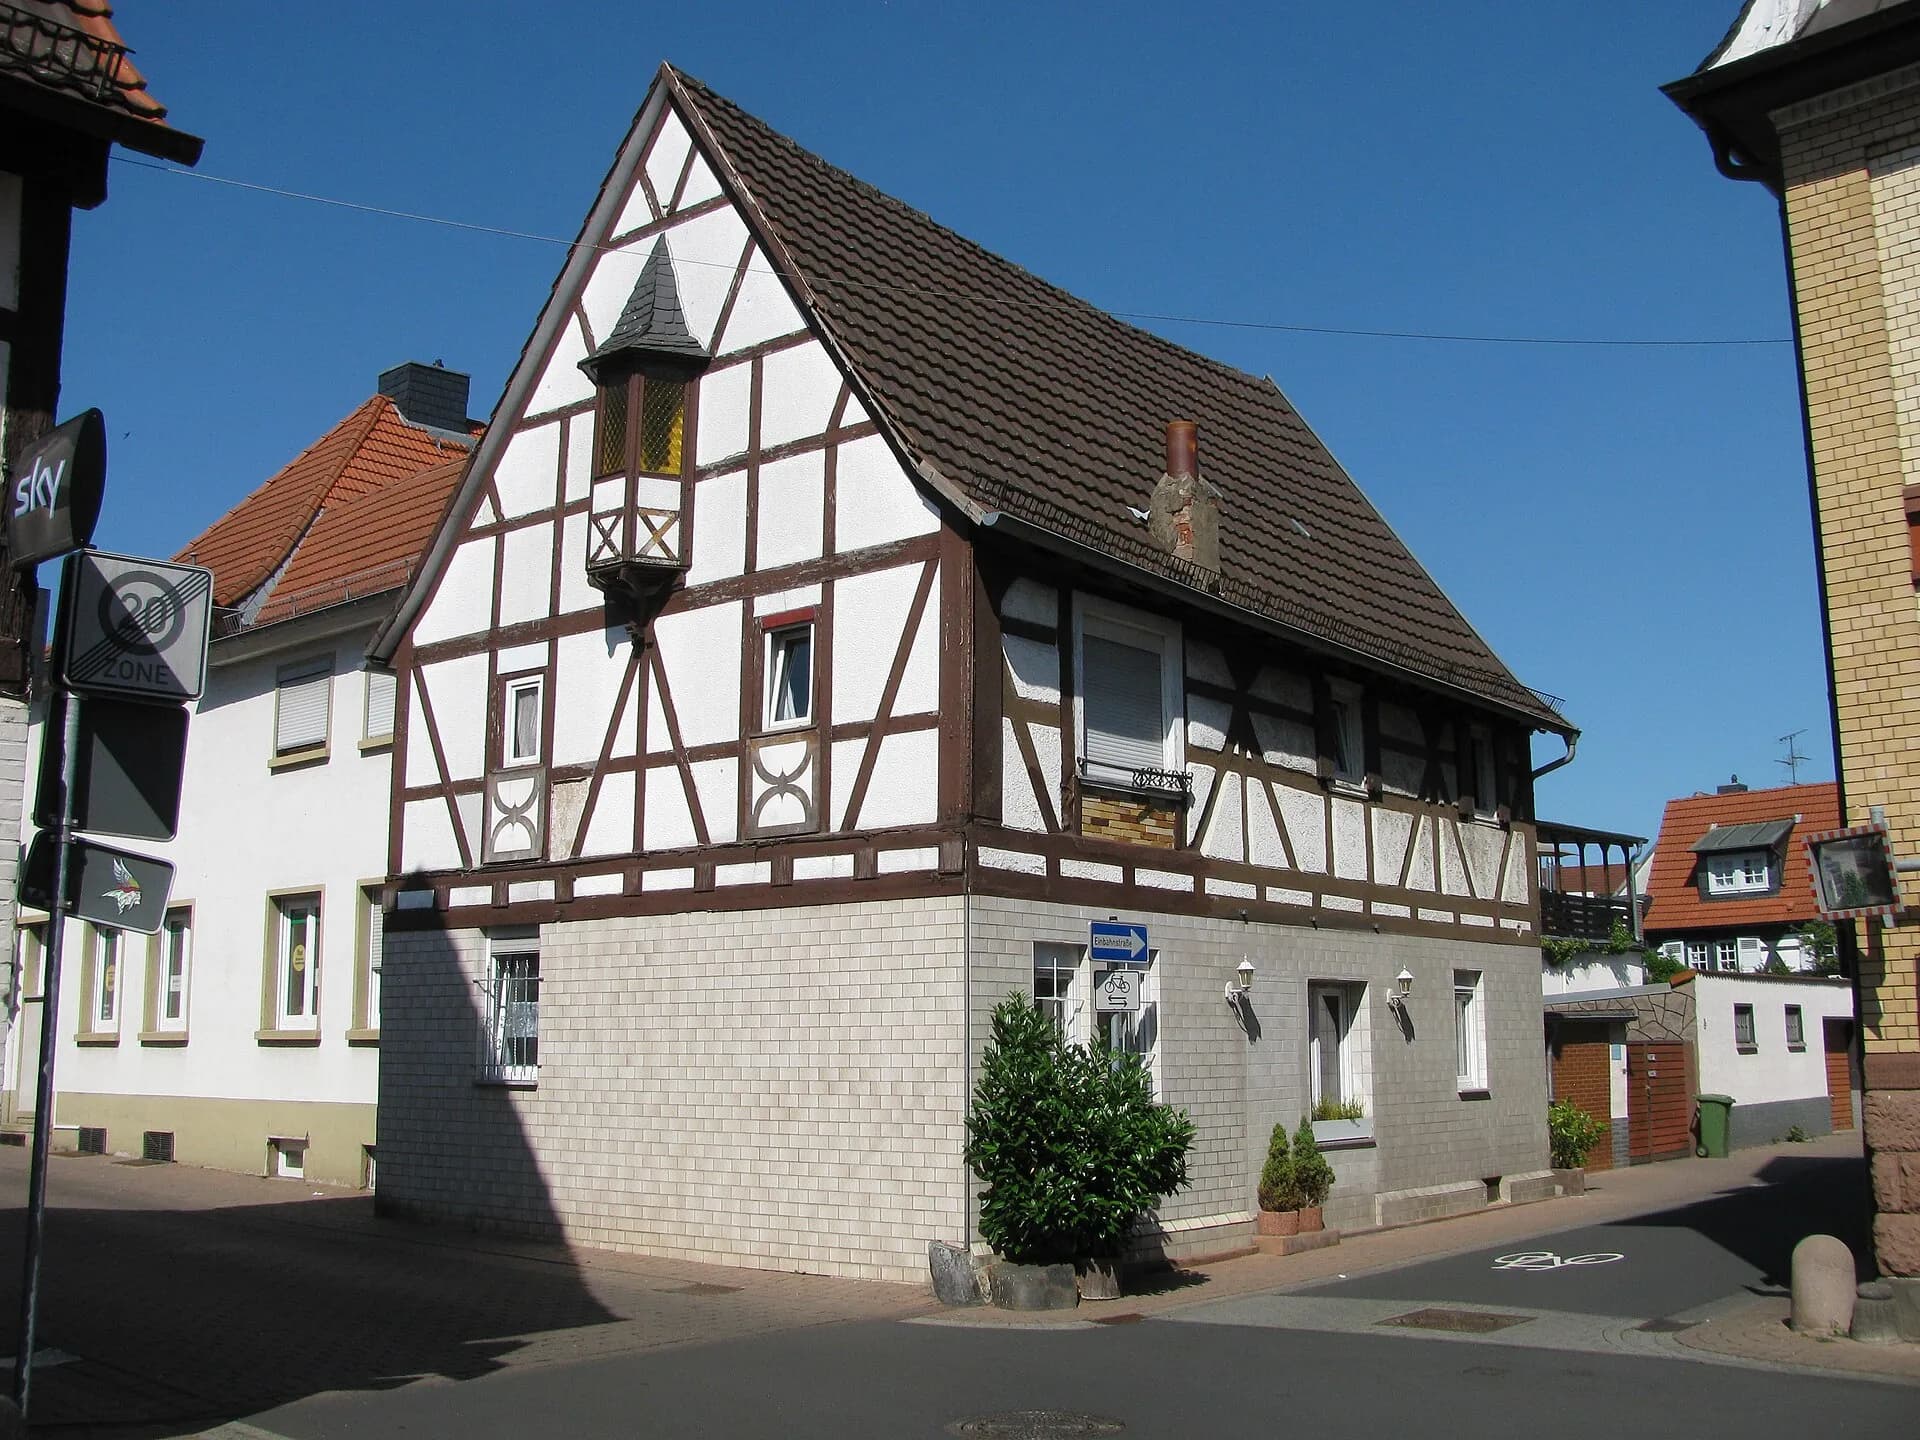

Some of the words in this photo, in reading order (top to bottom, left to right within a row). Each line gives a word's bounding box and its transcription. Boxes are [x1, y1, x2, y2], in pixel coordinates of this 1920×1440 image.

[15, 455, 65, 519] sky
[118, 592, 167, 634] 20
[103, 657, 170, 685] ZONE
